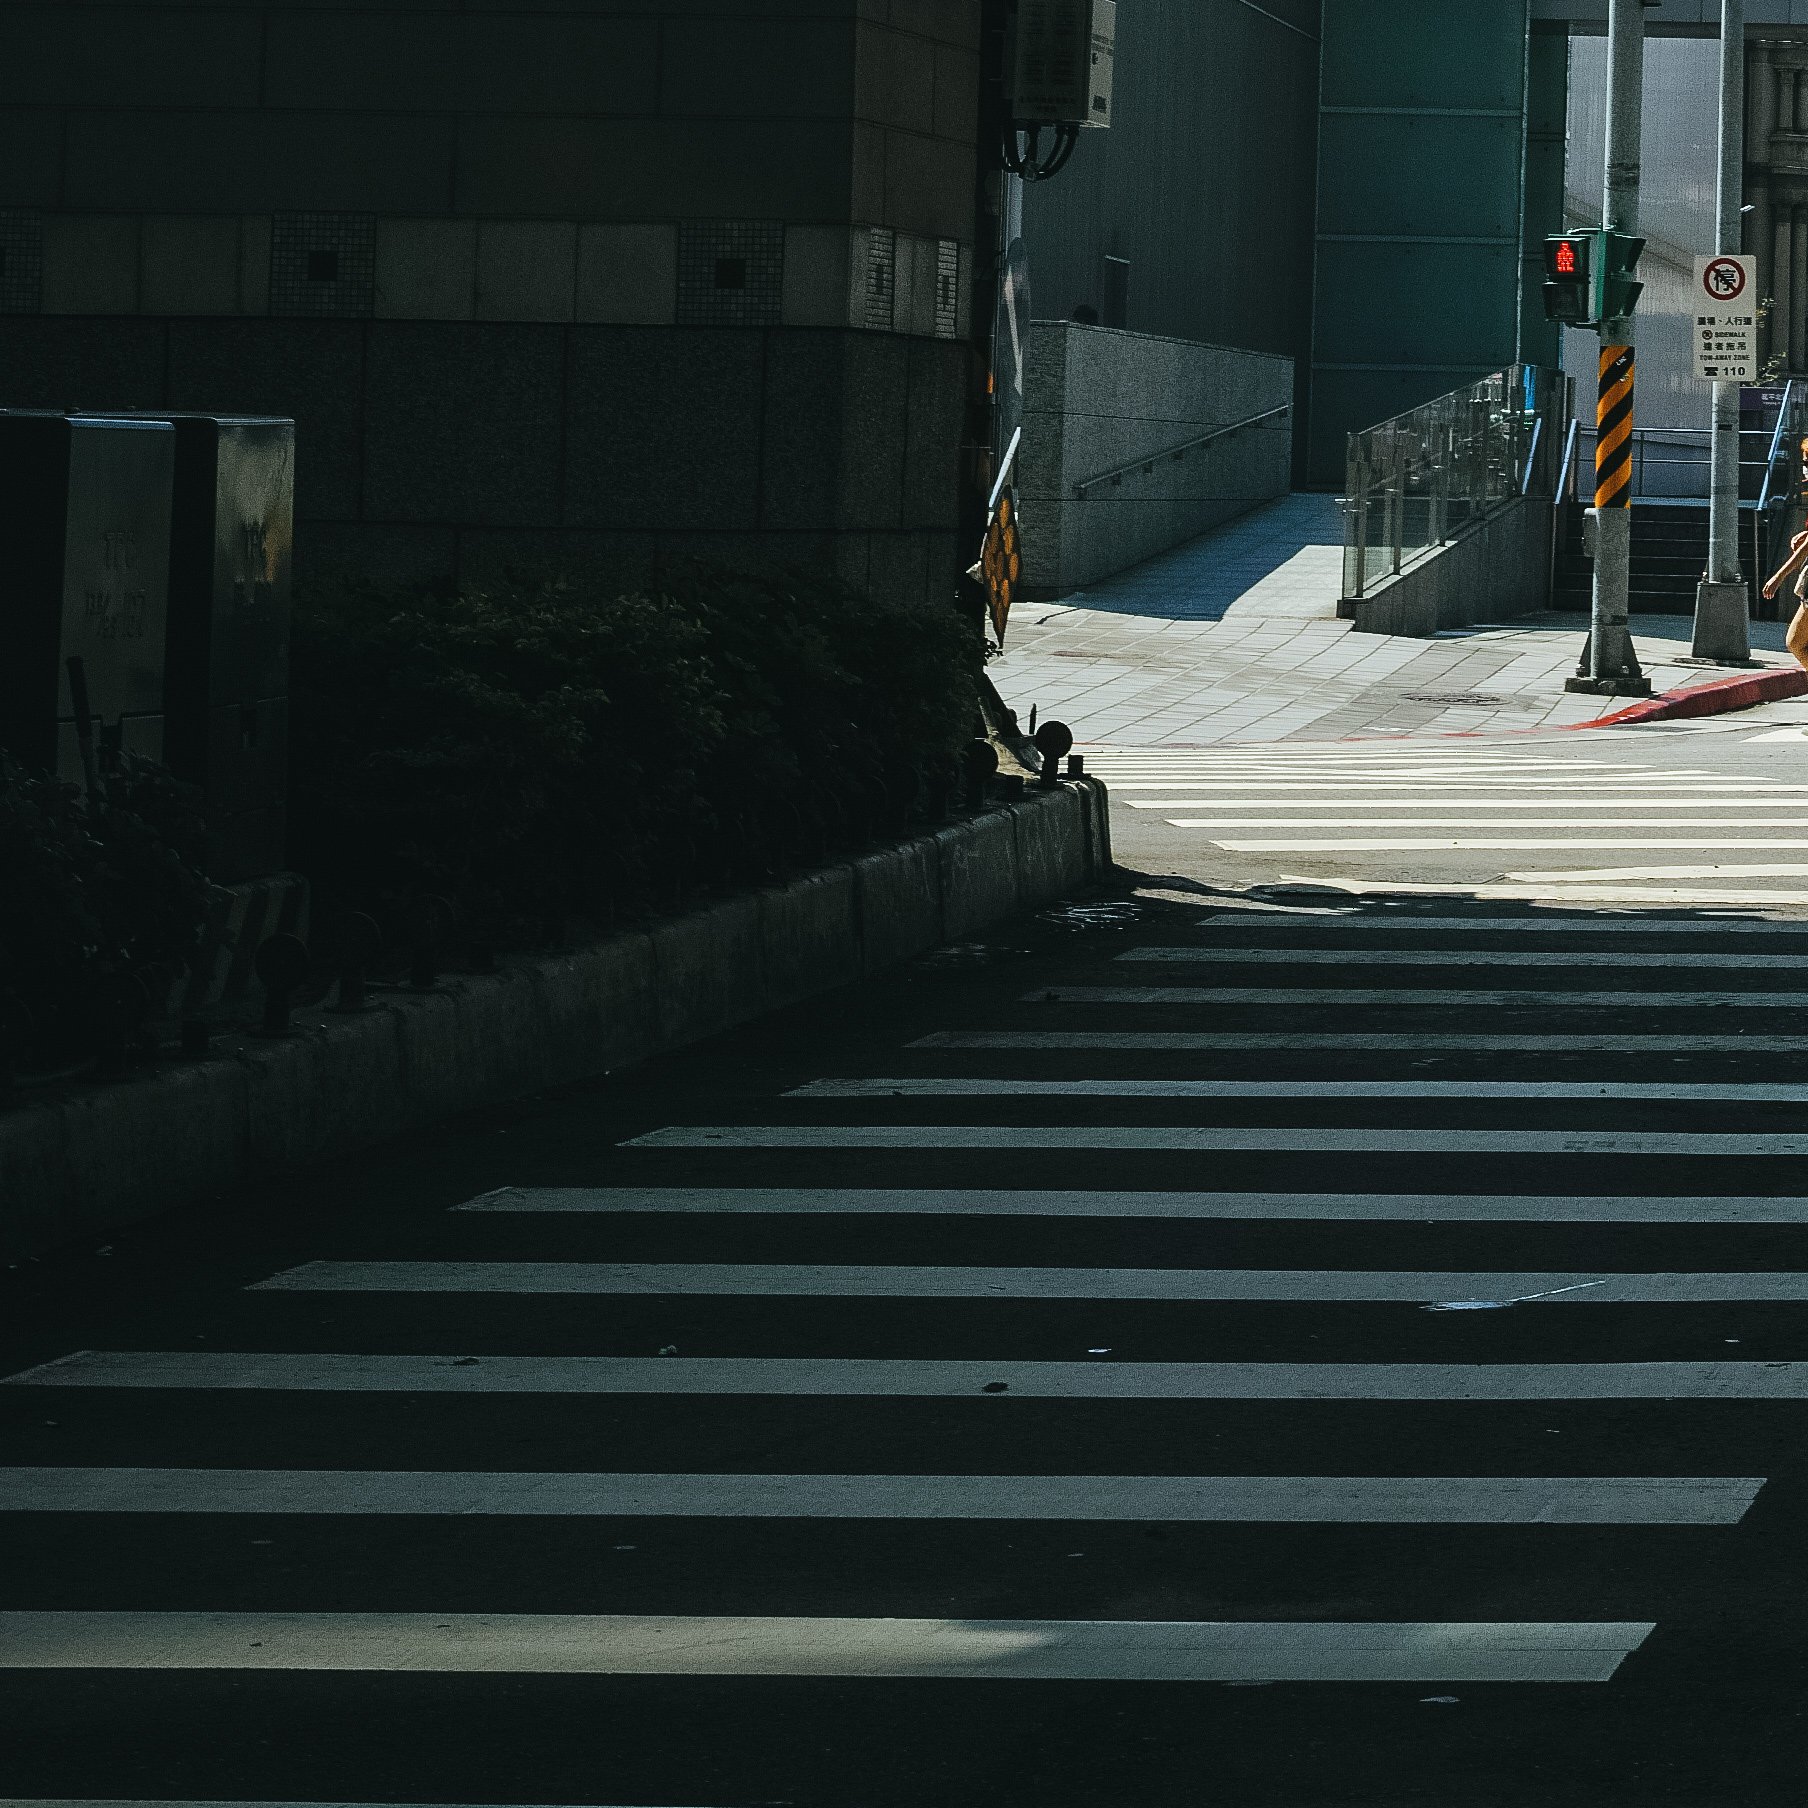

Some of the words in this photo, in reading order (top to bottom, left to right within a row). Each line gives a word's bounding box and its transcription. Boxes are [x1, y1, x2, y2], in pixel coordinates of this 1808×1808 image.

[1703, 342, 1747, 351] 違者拖吊
[1722, 366, 1746, 376] 110
